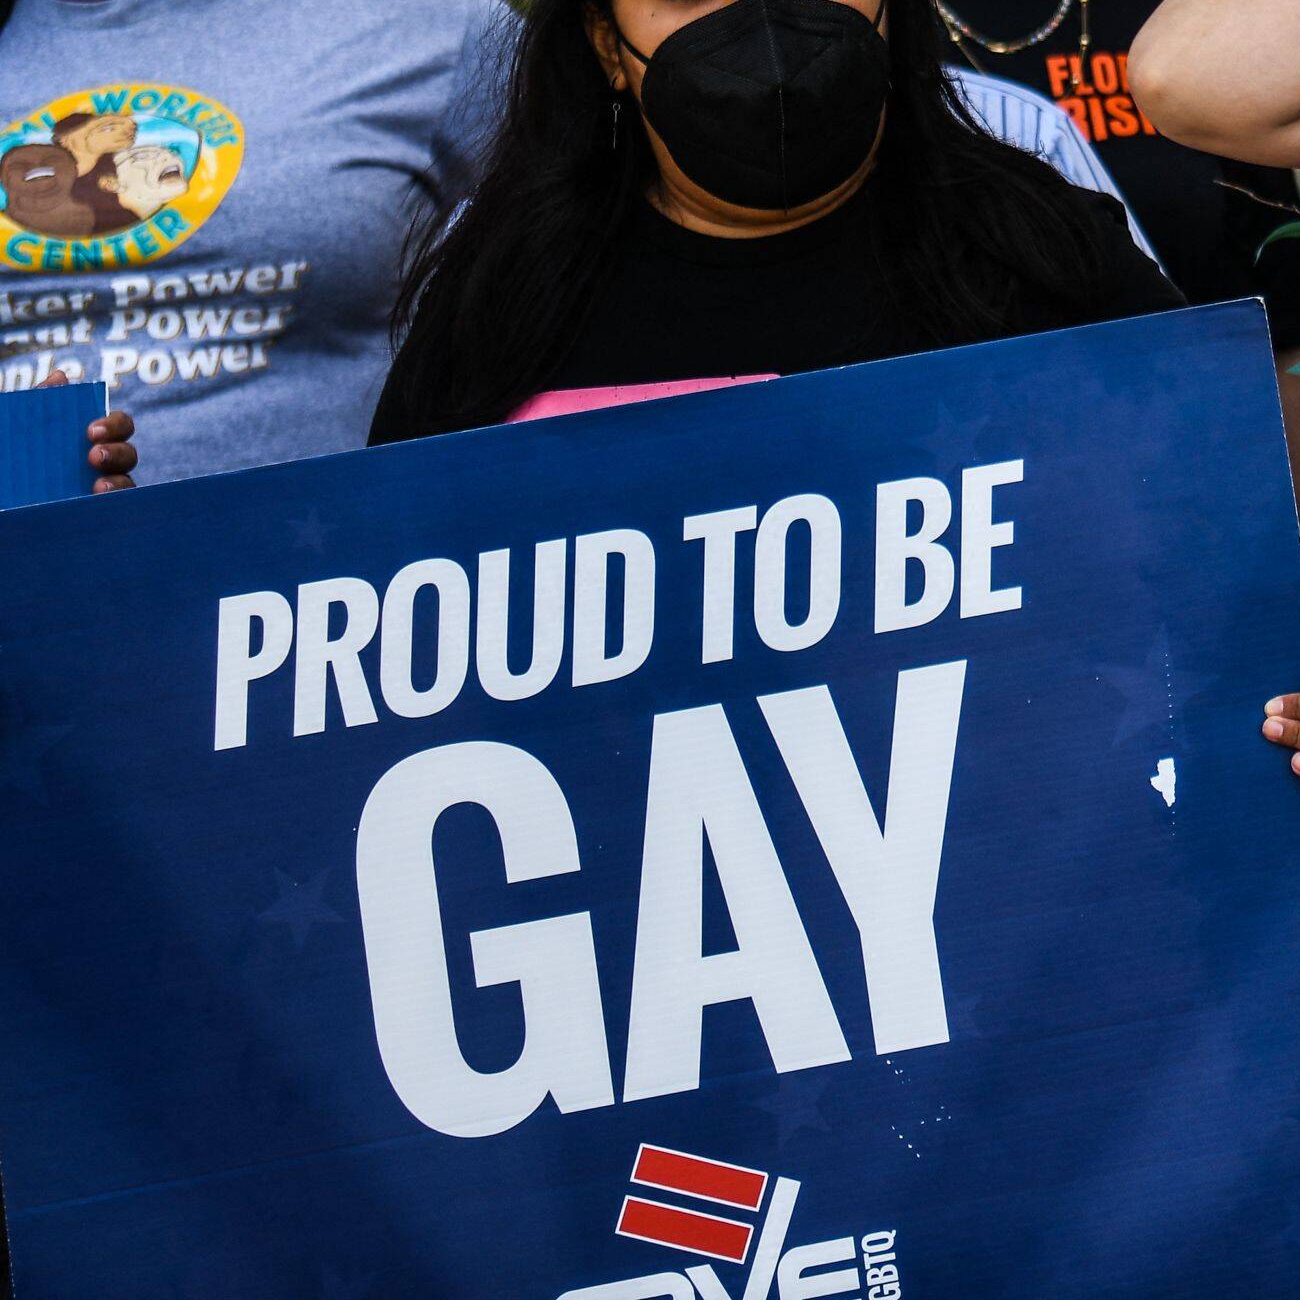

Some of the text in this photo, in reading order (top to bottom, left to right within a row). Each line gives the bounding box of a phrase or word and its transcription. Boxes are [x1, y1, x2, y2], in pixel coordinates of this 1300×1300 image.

[6, 209, 191, 271] CENTER
[111, 260, 309, 307] Power
[105, 304, 291, 342] Power
[101, 340, 274, 388] Power
[214, 458, 1024, 751] PROUD TO BE
[355, 658, 968, 1138] GAY
[861, 1229, 902, 1300] GBTQ
